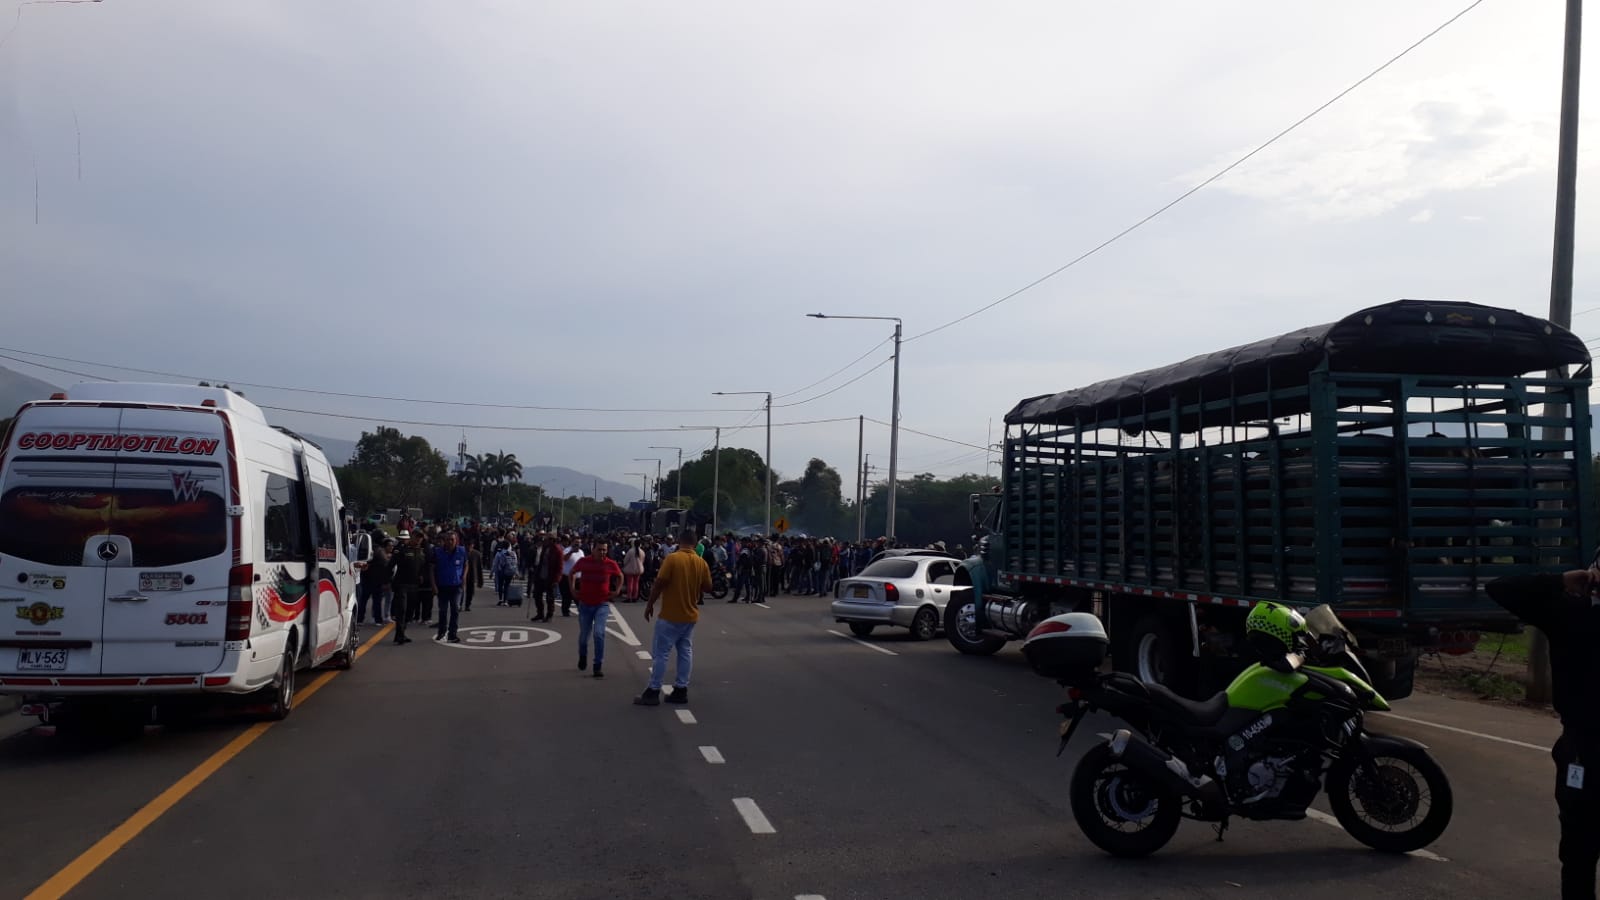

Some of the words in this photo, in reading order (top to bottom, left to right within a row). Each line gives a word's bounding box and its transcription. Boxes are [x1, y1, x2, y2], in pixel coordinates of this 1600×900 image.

[18, 431, 220, 455] COOPTMOTILON
[466, 630, 529, 643] 30
[20, 651, 66, 665] WLV-563
